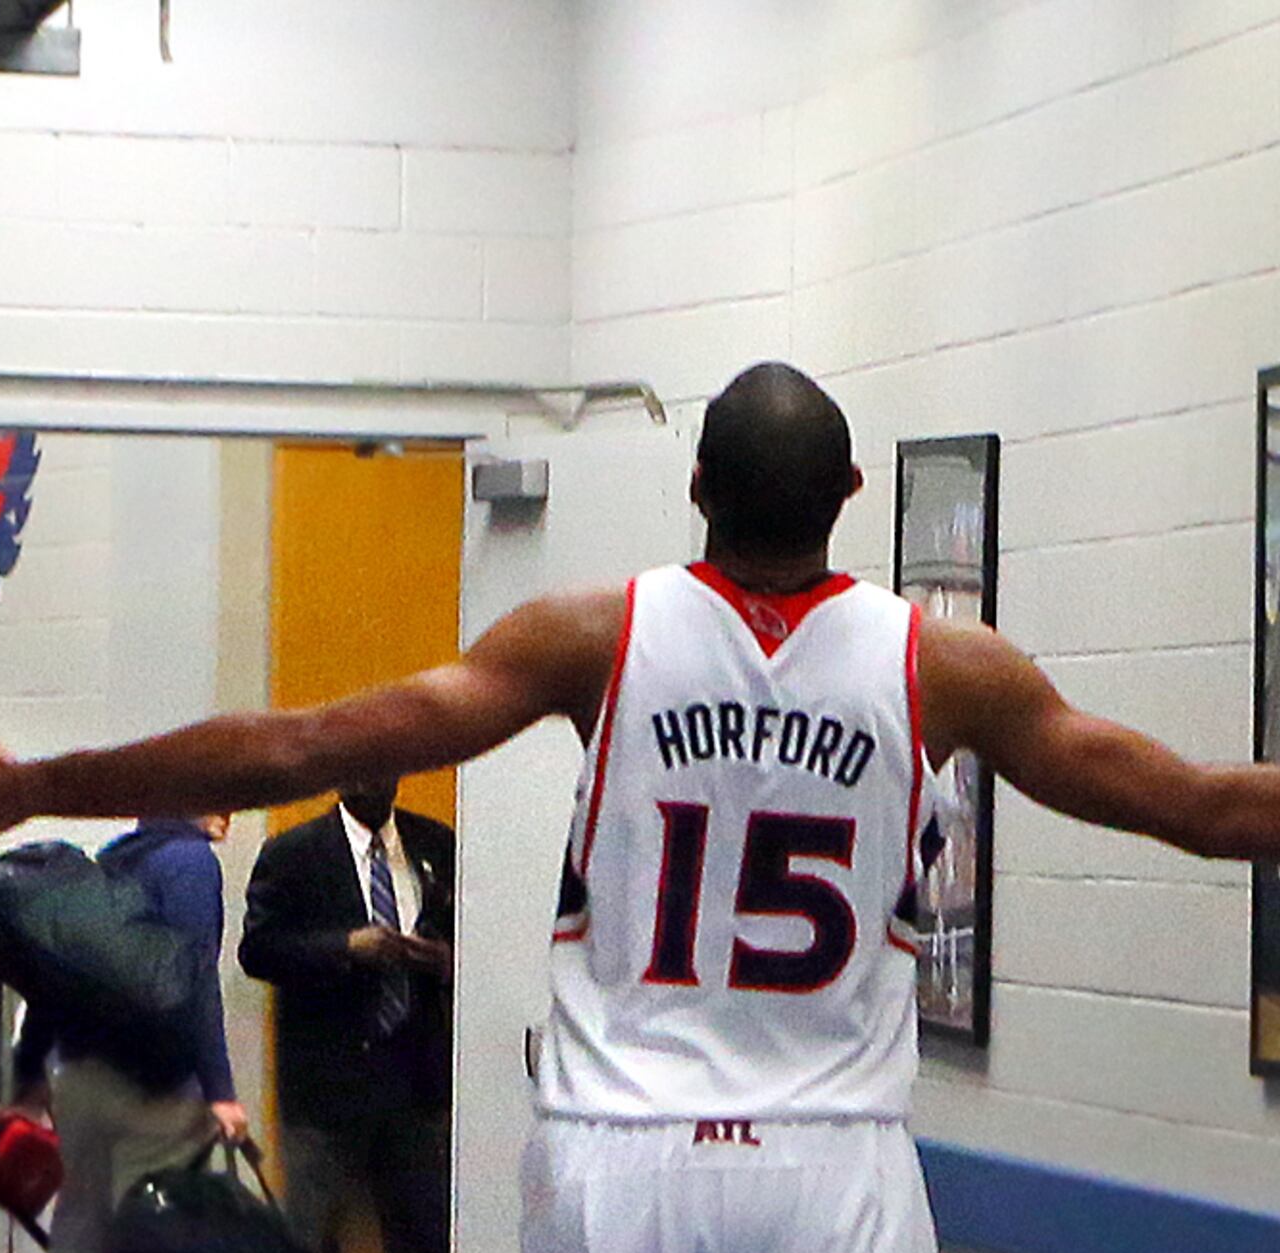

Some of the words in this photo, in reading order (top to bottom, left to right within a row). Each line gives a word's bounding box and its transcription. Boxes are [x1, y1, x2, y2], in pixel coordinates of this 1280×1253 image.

[652, 701, 876, 787] HORFORD
[641, 800, 857, 993] 15
[693, 1119, 761, 1146] ATL
